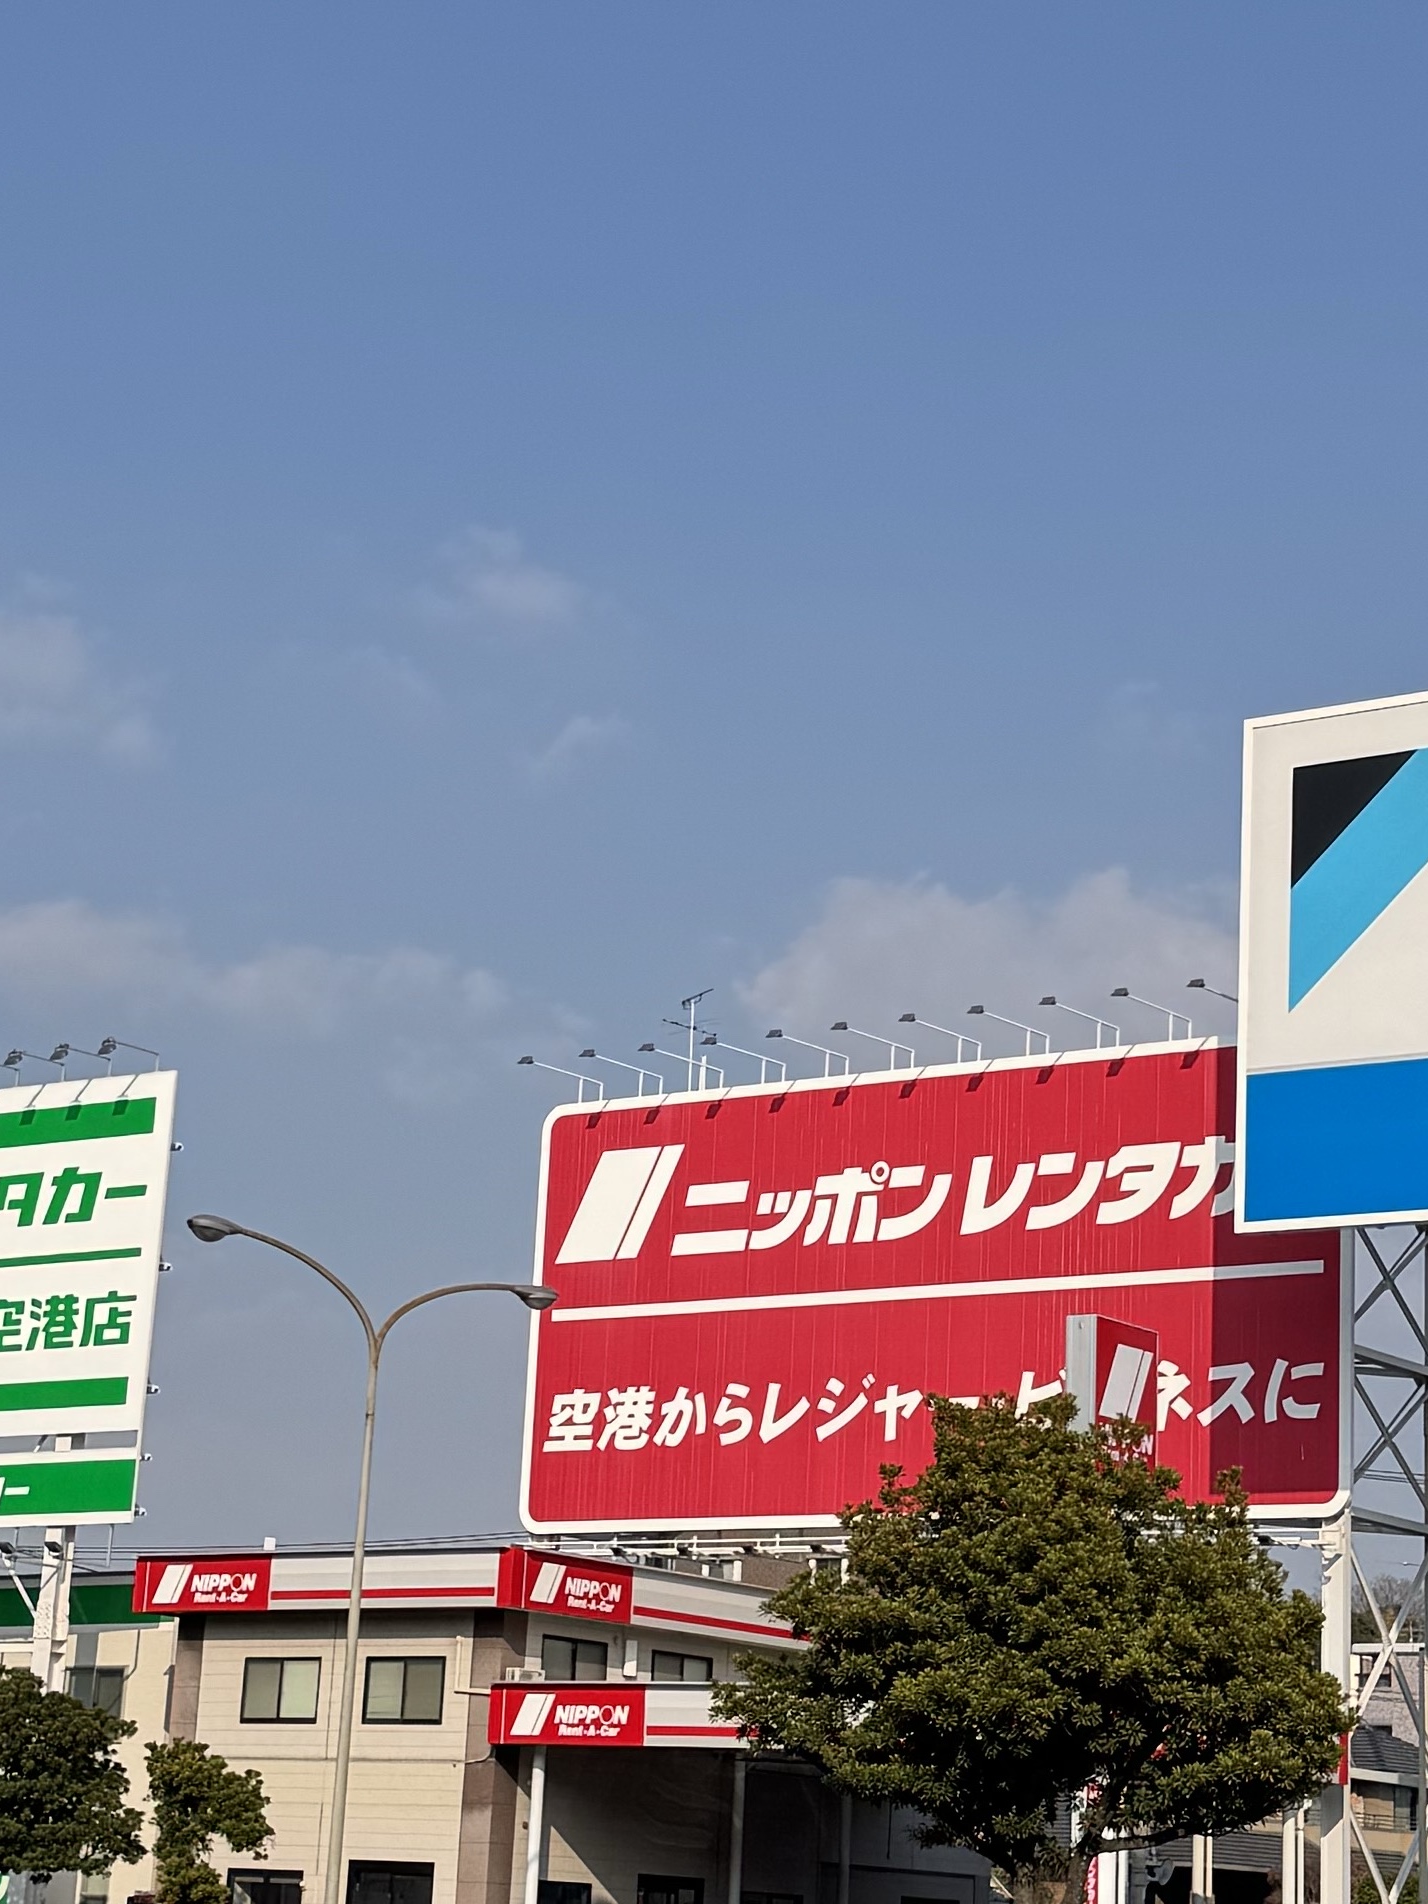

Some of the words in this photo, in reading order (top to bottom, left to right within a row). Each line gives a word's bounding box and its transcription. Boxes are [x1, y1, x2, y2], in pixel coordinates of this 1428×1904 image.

[191, 1573, 257, 1592] NIPPON
[564, 1577, 622, 1602] NIPPON
[554, 1705, 630, 1725] NIPPON
